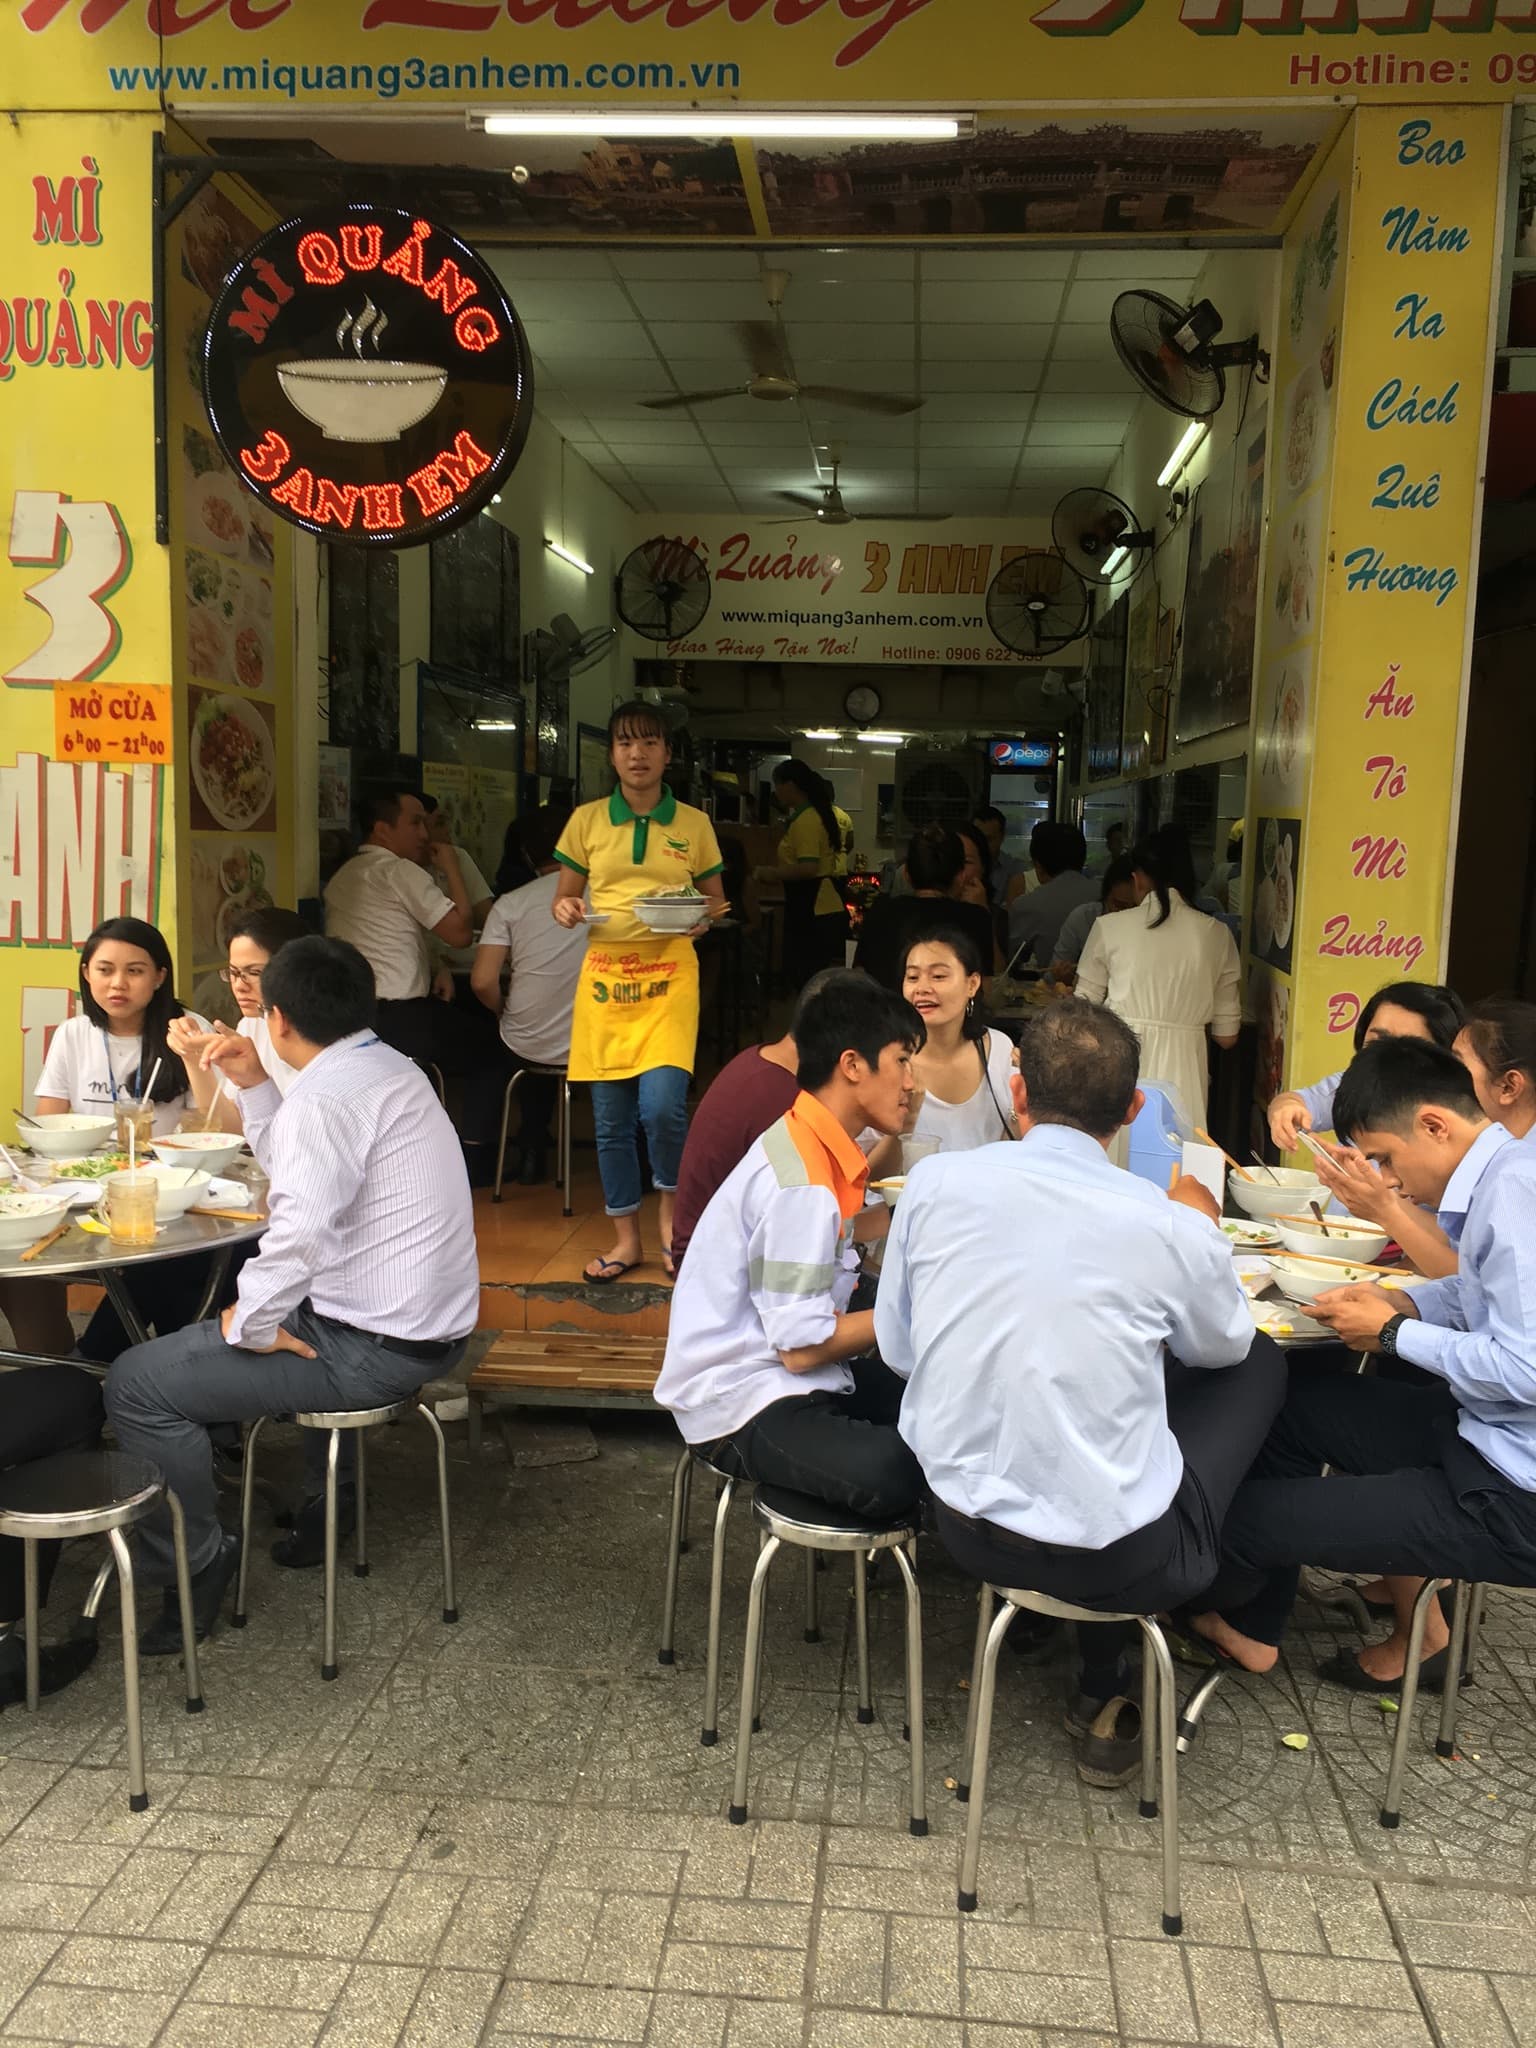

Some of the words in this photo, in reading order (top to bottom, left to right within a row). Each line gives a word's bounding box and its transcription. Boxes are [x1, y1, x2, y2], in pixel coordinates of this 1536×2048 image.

[109, 57, 741, 97] www.miquang3anhem.com.vn
[1289, 53, 1469, 86] Hotline:
[1397, 119, 1466, 167] Bao
[1381, 206, 1472, 254] Năm
[297, 219, 500, 352] QUẢNG
[1393, 293, 1446, 341] Xa
[1366, 378, 1460, 430] Cách
[240, 430, 291, 482] 3
[271, 467, 404, 530] ANH
[406, 429, 494, 517] EM
[1371, 463, 1441, 510] Quê
[2, 490, 133, 687] 3
[715, 533, 845, 596] Quảng
[861, 541, 892, 594] 3
[897, 544, 993, 595] ANH
[1343, 546, 1460, 608] Hương
[721, 609, 984, 629] www.miquang3anhem.com.vn
[666, 638, 708, 658] Giao
[714, 637, 765, 660] Hàng
[774, 637, 809, 658] Tận
[881, 646, 940, 661] Hotline:
[946, 647, 981, 661] 0906
[985, 647, 1011, 661] 622
[109, 689, 157, 721] CỬA
[1364, 664, 1415, 720] Ăn
[1365, 755, 1408, 800] Tô
[0, 751, 164, 955] ANH
[1351, 835, 1408, 880] Mì
[1318, 914, 1424, 972] Quảng
[592, 981, 609, 1003] 3
